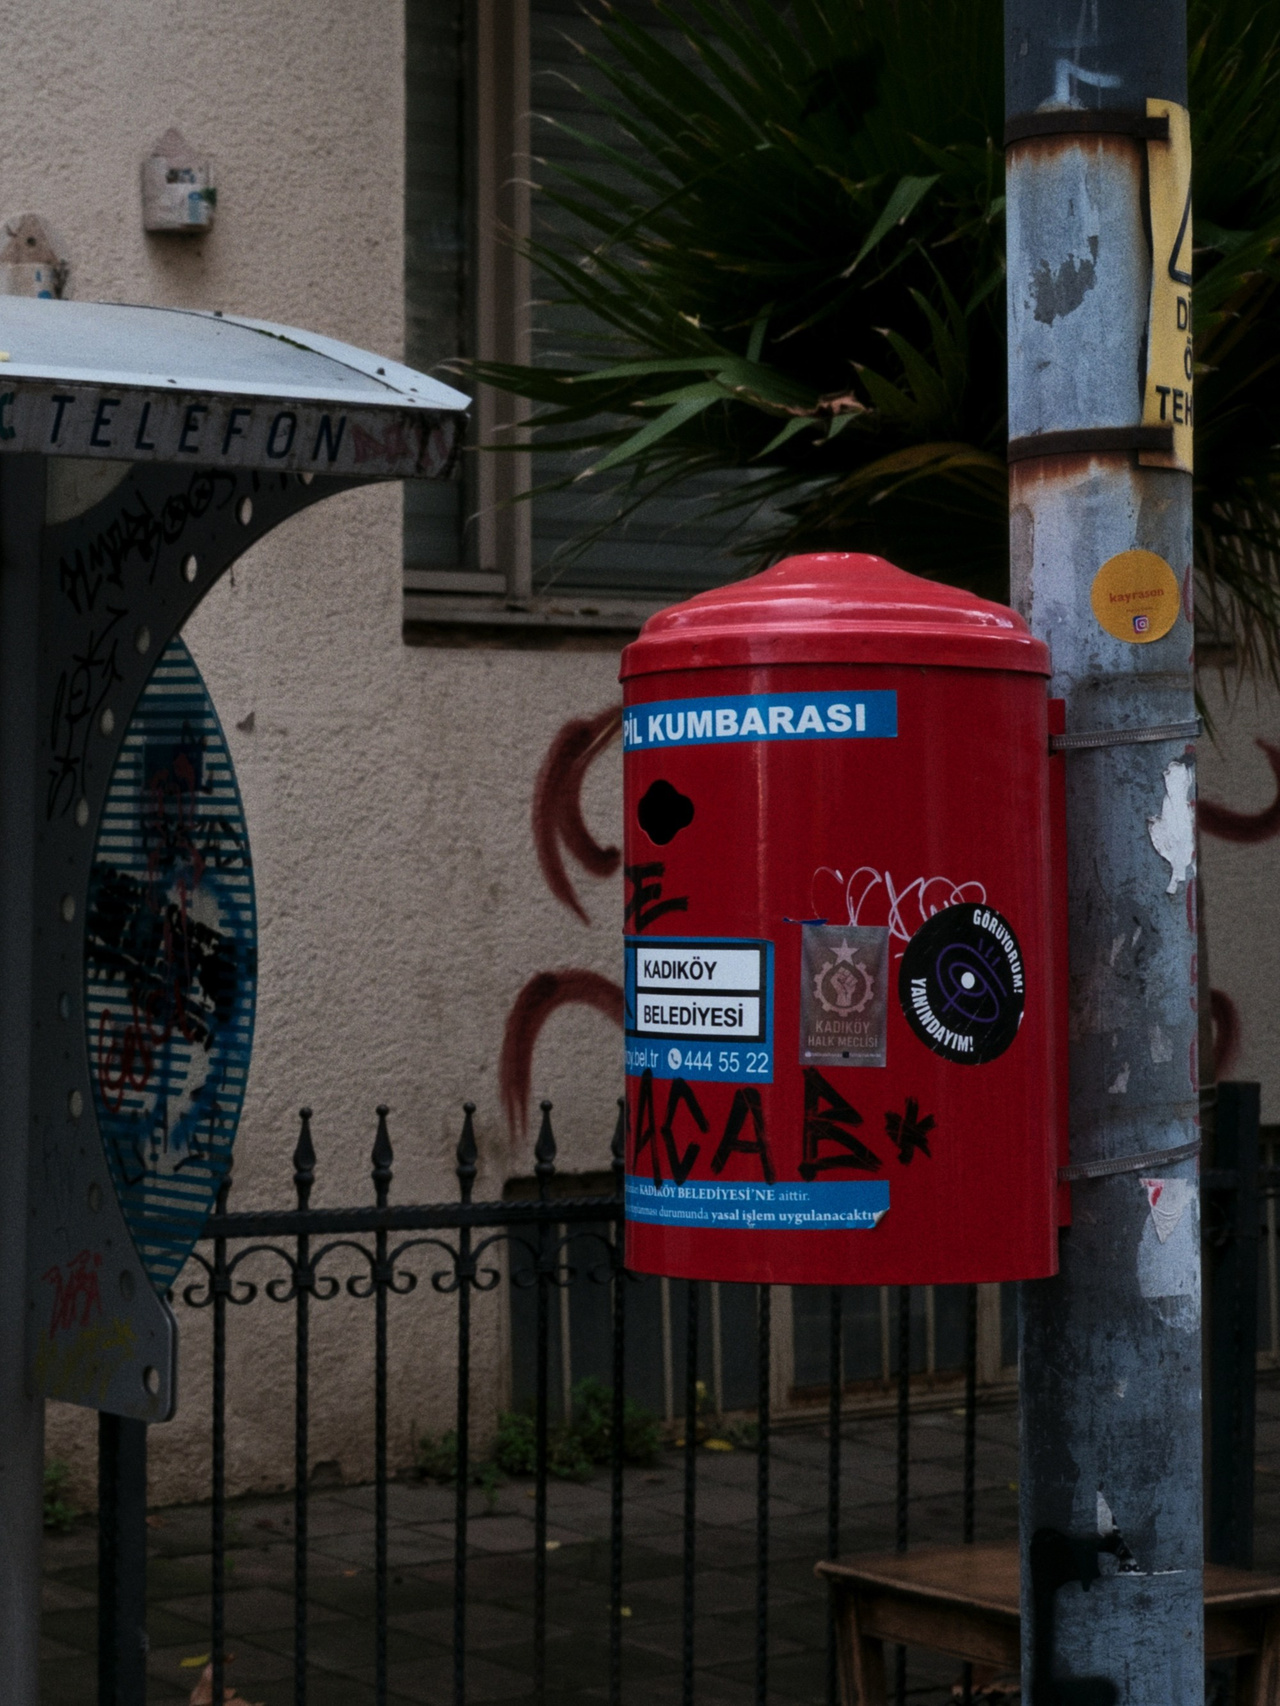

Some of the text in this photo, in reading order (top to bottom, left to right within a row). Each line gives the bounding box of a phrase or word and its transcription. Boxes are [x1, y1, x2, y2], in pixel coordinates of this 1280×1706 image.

[50, 395, 348, 463] TELEFON
[648, 703, 866, 743] KUMBARASI
[973, 908, 1024, 994] GÖRÜYORUM!
[644, 956, 717, 980] KADIKÖY
[644, 1002, 743, 1027] BELEDİYESİ
[815, 1018, 870, 1034] KADIKÖY
[910, 977, 975, 1053] YANINDAYIM!
[808, 1035, 878, 1048] HALK MECLİSİ
[684, 1051, 713, 1071] 444
[718, 1052, 740, 1072] 55
[746, 1052, 769, 1073] 22
[711, 1208, 739, 1223] yasal
[779, 1208, 880, 1225] uygulanacaktı
